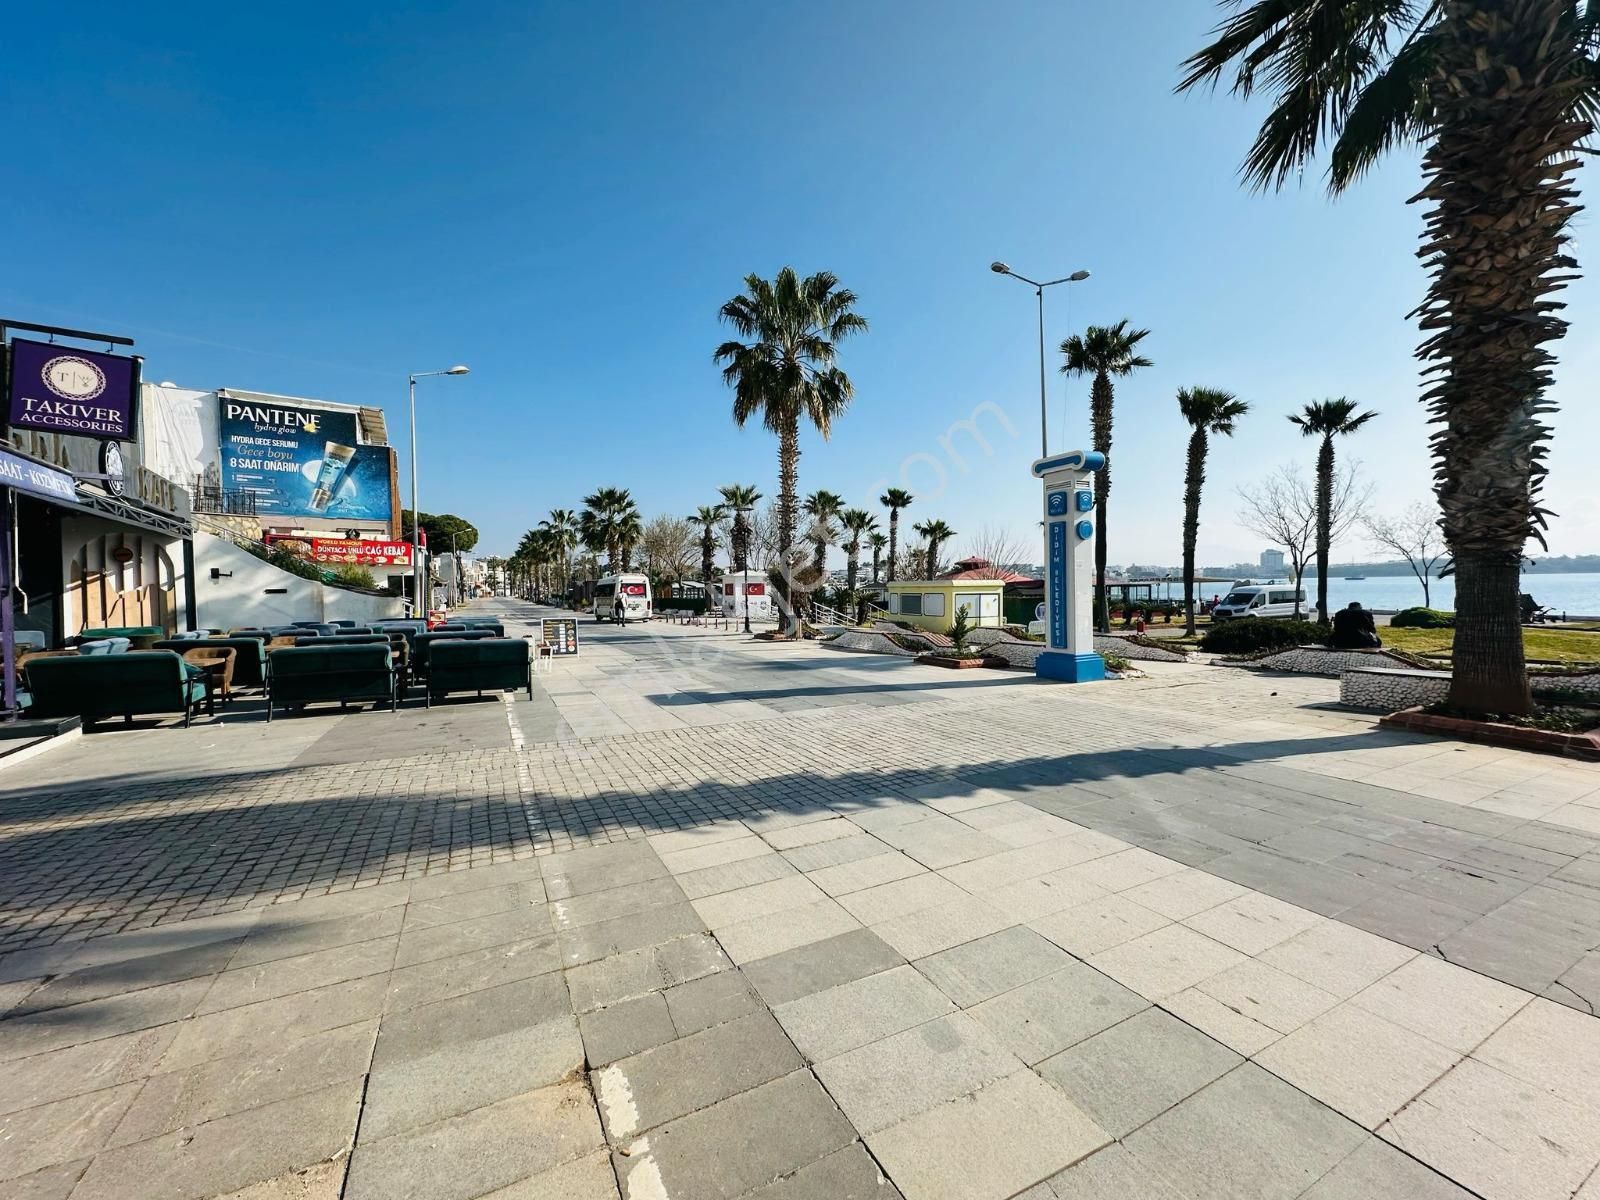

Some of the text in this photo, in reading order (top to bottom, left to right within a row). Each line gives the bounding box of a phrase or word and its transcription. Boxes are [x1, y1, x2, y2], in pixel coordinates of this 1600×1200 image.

[21, 398, 122, 423] TAKIVER
[227, 405, 321, 429] PANTENE
[20, 413, 123, 433] ACCESSORIES
[254, 423, 296, 434] hydra glow
[231, 435, 254, 445] HYDRA
[254, 437, 271, 446] GECE
[237, 445, 294, 462] Gece boyu
[230, 457, 237, 468] 8
[238, 458, 262, 470] SAAT
[383, 545, 406, 556] KEBAP
